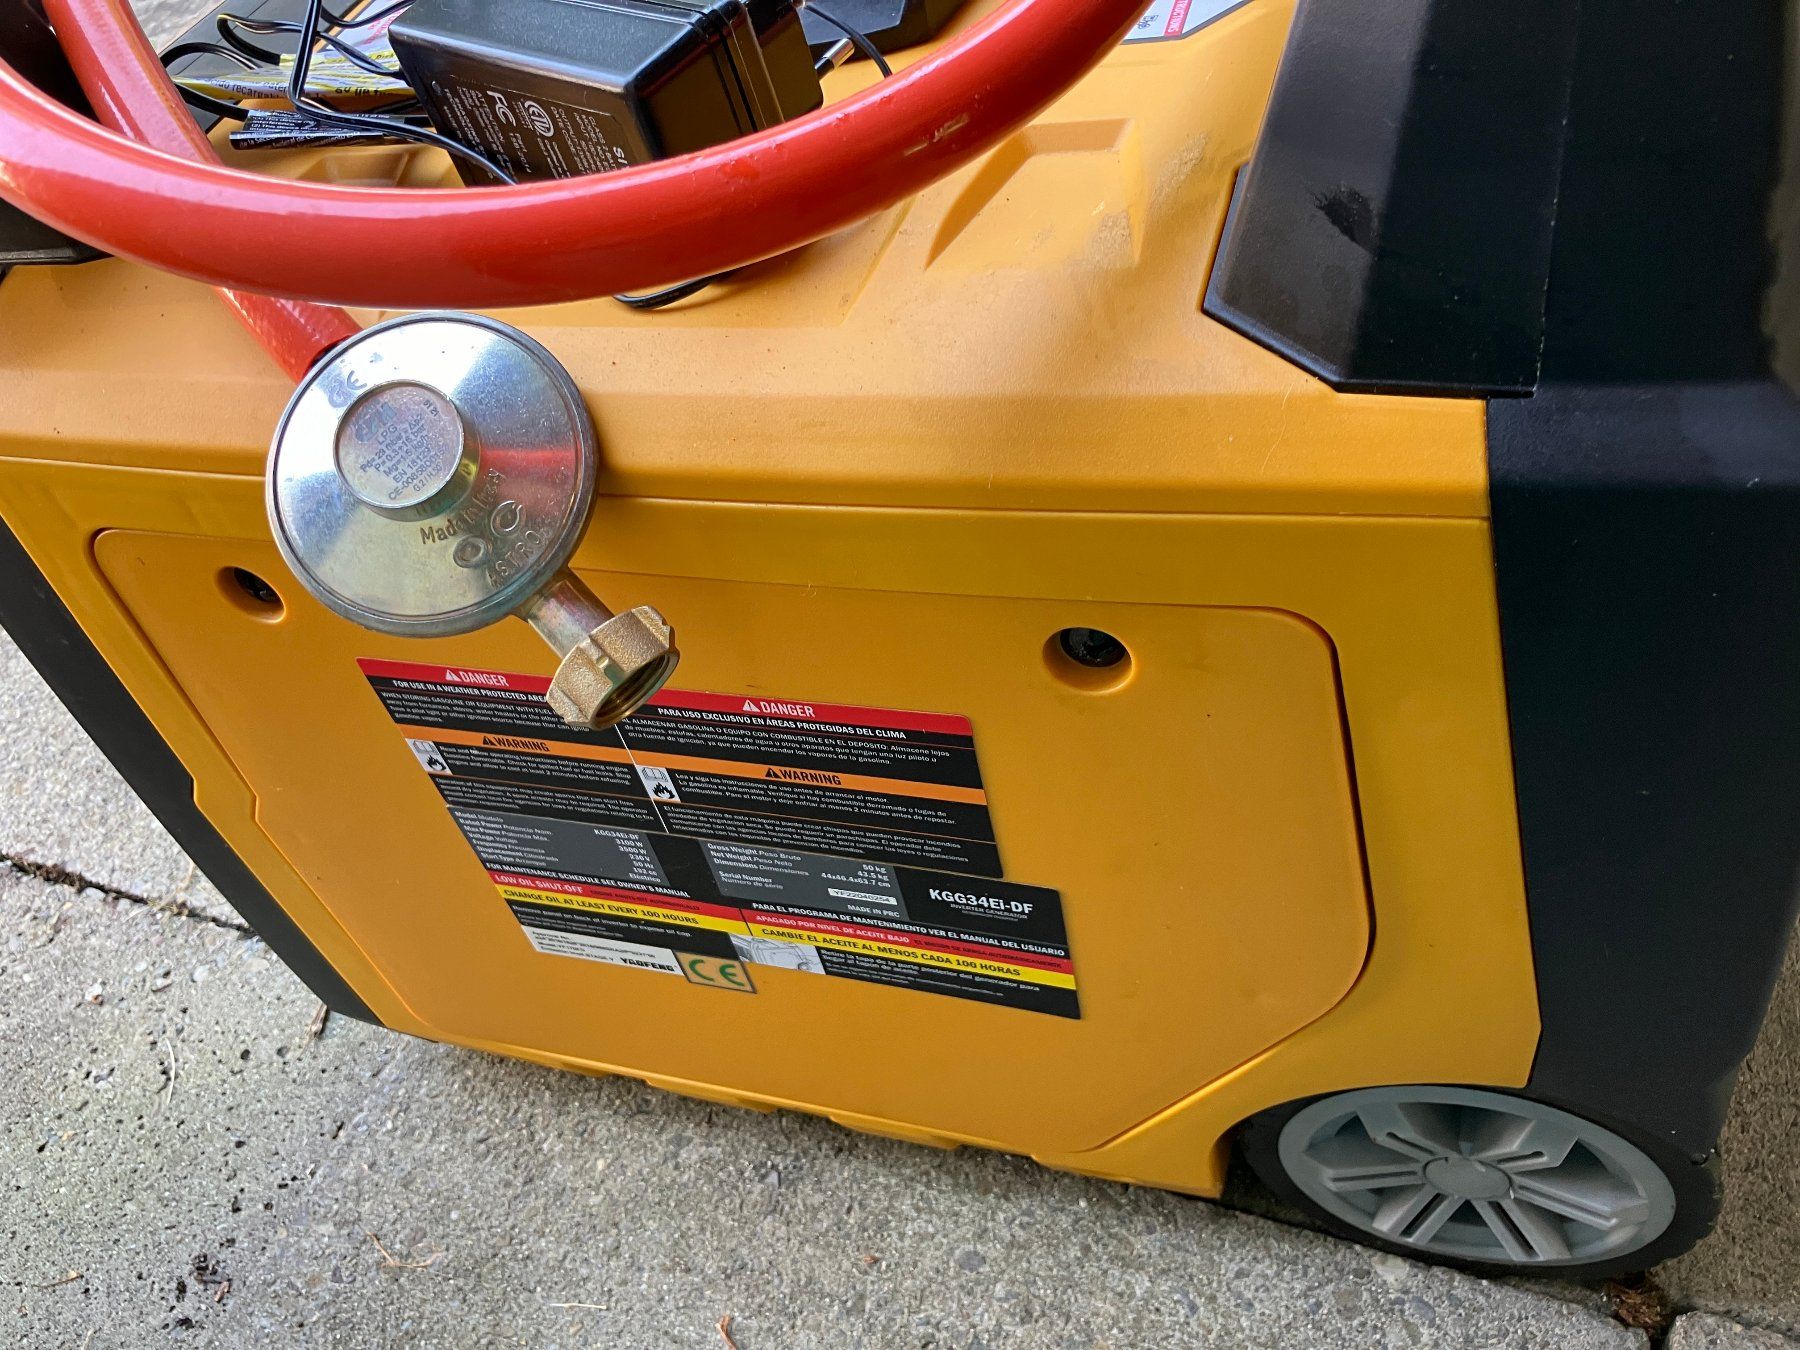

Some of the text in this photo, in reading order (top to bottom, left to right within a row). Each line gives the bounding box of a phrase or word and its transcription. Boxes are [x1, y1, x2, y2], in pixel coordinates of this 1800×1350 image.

[377, 424, 397, 445] LPG
[420, 519, 464, 544] Made
[458, 670, 510, 687] DANGER
[392, 679, 411, 688] FOR
[408, 681, 428, 690] USE
[424, 683, 437, 691] IN
[441, 685, 481, 695] WEATHER
[479, 688, 528, 700] PROTECTED
[759, 701, 815, 717] DANGER
[656, 707, 907, 740] PARA USO EXCLUSIVO EN ÁREAS PROTEGIDAS DEL CLIMA
[492, 736, 550, 751] WARNING
[631, 718, 676, 727] ALMACENAR
[676, 722, 715, 731] GASOLINA
[722, 727, 751, 735] EQUIPO
[769, 732, 823, 743] COMBUSTIBLE
[889, 745, 929, 754] Almacene
[930, 749, 950, 757] lejos
[779, 769, 842, 785] WARNING
[614, 838, 635, 846] 3100
[706, 843, 802, 861] Gross Weight Peso Bruto
[725, 853, 753, 862] Weight
[752, 856, 772, 864] Peso
[713, 858, 809, 876] Dimensions Dimensiones
[856, 870, 876, 878] 43.5
[485, 862, 690, 897] FOR MAINTENANCE SCHEDULE SEE OWNER'S MANUAL
[494, 874, 585, 894] LOW OIL SHUT-OFF
[741, 874, 772, 883] Number
[502, 888, 544, 901] CHANGE
[561, 897, 574, 905] AT
[575, 899, 606, 910] LEAST
[606, 904, 640, 915] EVERY
[640, 909, 661, 918] 100
[661, 912, 699, 924] HOURS
[846, 904, 870, 912] MADE
[882, 909, 900, 917] PRC
[751, 902, 776, 911] PARA
[776, 905, 788, 913] EL
[787, 906, 839, 920] PROGRAMA
[852, 916, 926, 933] MANTENIMIENTO
[927, 928, 946, 936] VER
[947, 931, 959, 939] EL
[959, 933, 999, 945] MANUAL
[1001, 940, 1021, 949] DEL
[1021, 943, 1065, 956] USUARIO
[754, 914, 797, 926] APAGADO
[816, 923, 841, 932] NIVEL
[855, 929, 886, 939] ACEITE
[887, 934, 909, 942] BAJO
[761, 928, 805, 940] CAMBIE
[820, 936, 859, 948] ACEITE
[860, 943, 875, 951] AL
[876, 945, 918, 958] MENOS
[920, 953, 952, 964] CADA
[955, 958, 977, 968] 100
[979, 963, 1020, 976] HORAS
